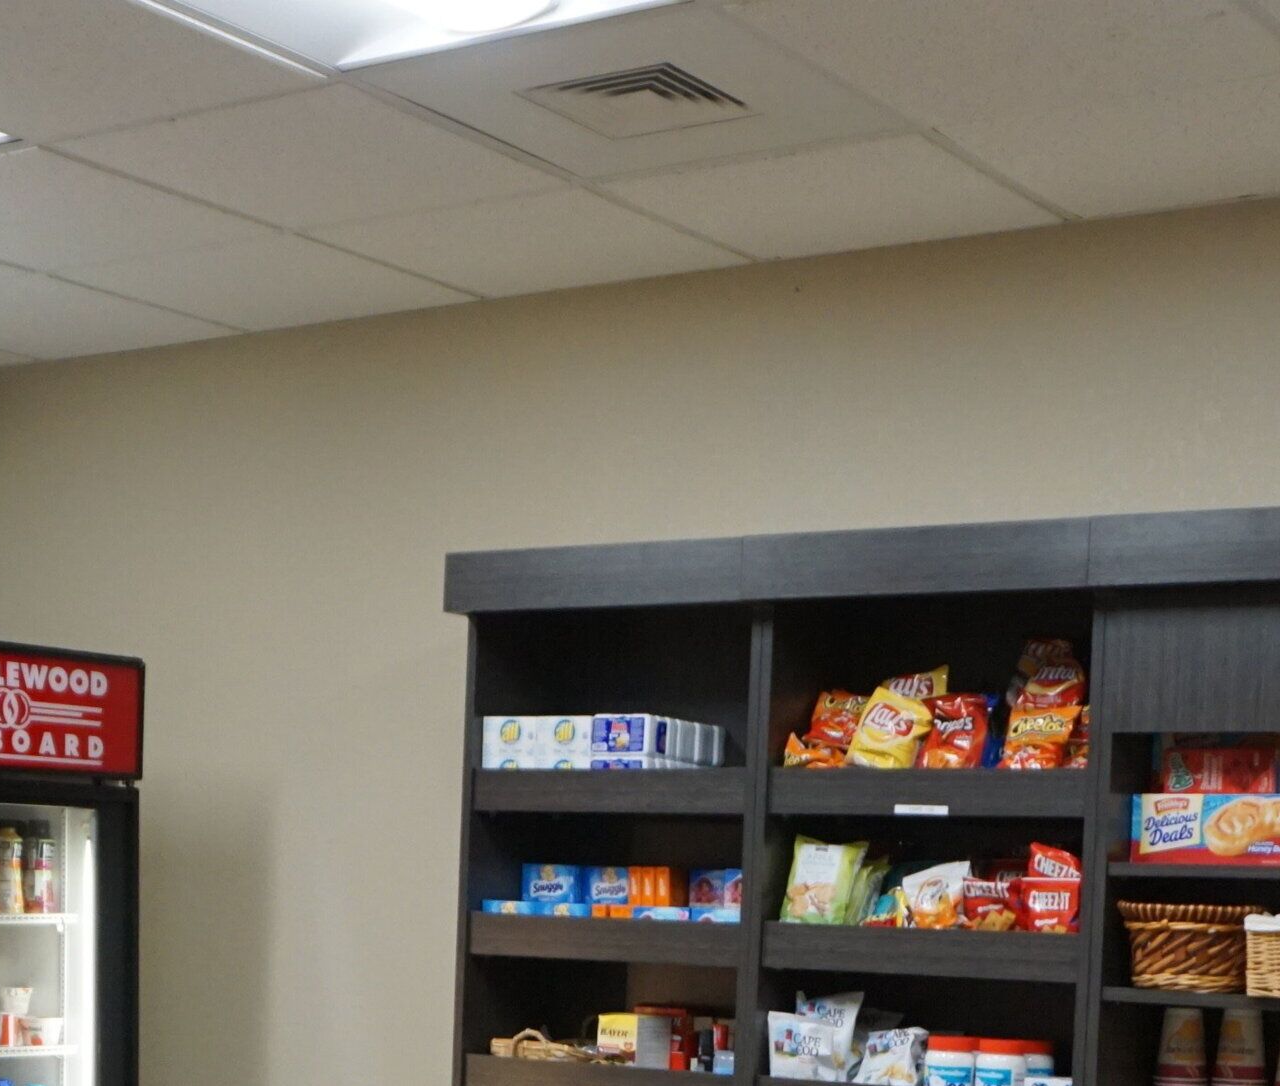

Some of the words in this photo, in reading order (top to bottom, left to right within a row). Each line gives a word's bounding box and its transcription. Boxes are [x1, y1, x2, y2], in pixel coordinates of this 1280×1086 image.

[1010, 715, 1065, 737] Cheetos
[1144, 811, 1199, 831] Delicious
[1148, 825, 1194, 847] Deals
[600, 1027, 629, 1039] BAYER
[793, 1032, 821, 1048] CAPE
